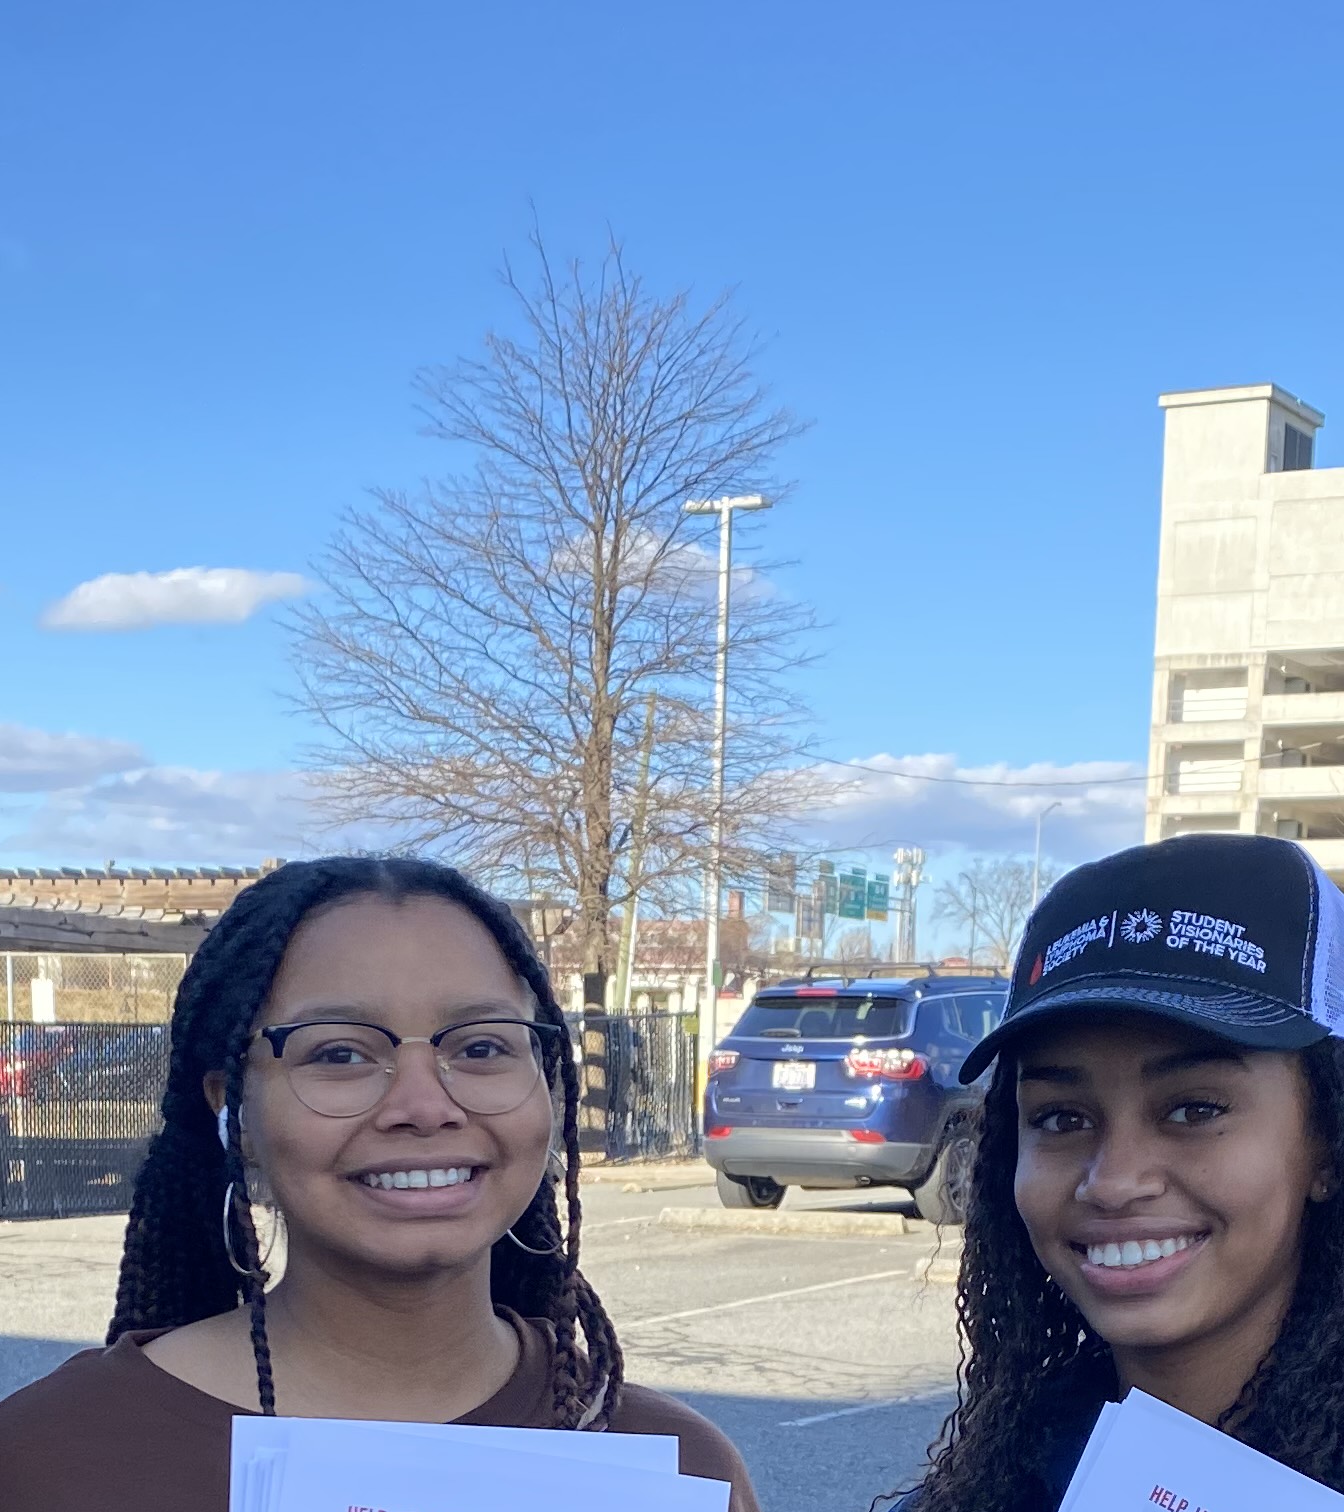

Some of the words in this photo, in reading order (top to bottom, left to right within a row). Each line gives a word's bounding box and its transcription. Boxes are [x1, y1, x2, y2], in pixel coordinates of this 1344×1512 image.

[1170, 922, 1265, 959] VISIONARIES
[1171, 910, 1246, 938] STUDENT
[1043, 941, 1088, 977] SOCIETY
[1166, 935, 1190, 949] OF
[1193, 939, 1225, 957] THE
[1228, 947, 1267, 974] YEAR
